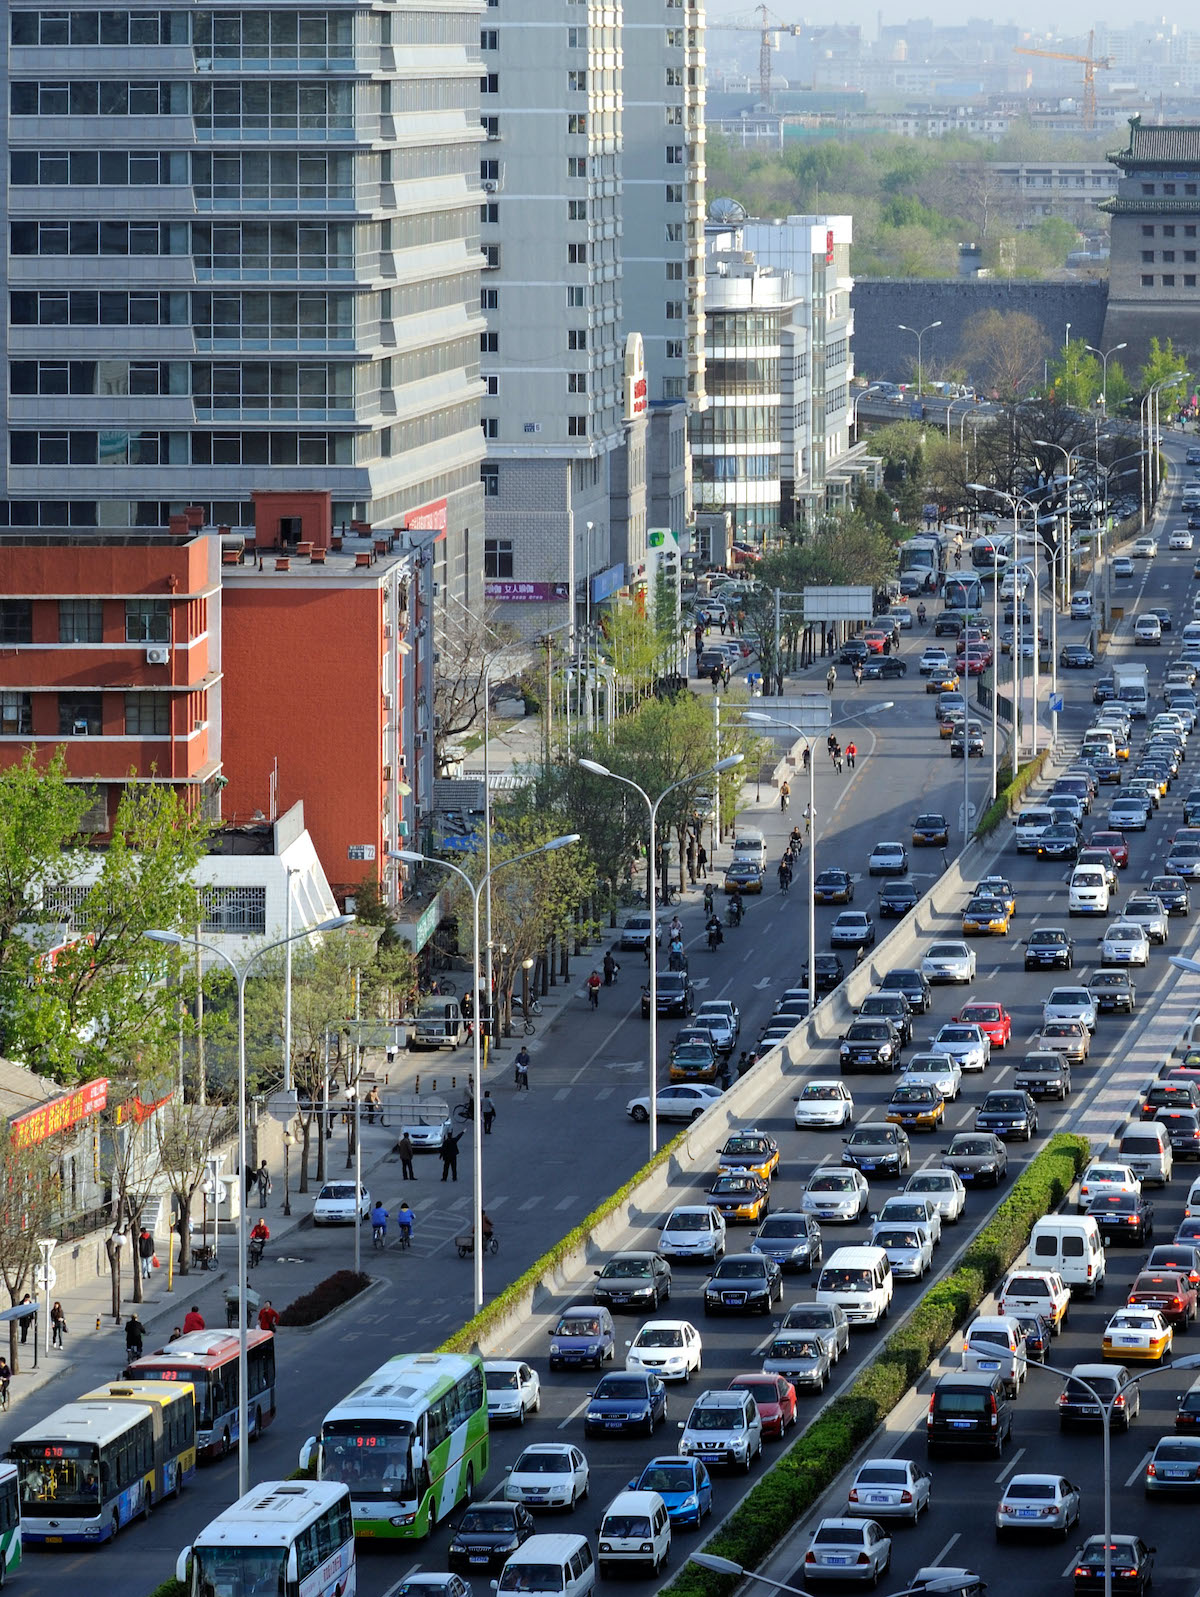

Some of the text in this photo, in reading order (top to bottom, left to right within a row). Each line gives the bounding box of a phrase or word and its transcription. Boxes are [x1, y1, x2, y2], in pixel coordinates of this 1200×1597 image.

[162, 1370, 177, 1380] 123
[357, 1437, 376, 1447] 919
[44, 1447, 63, 1457] 670
